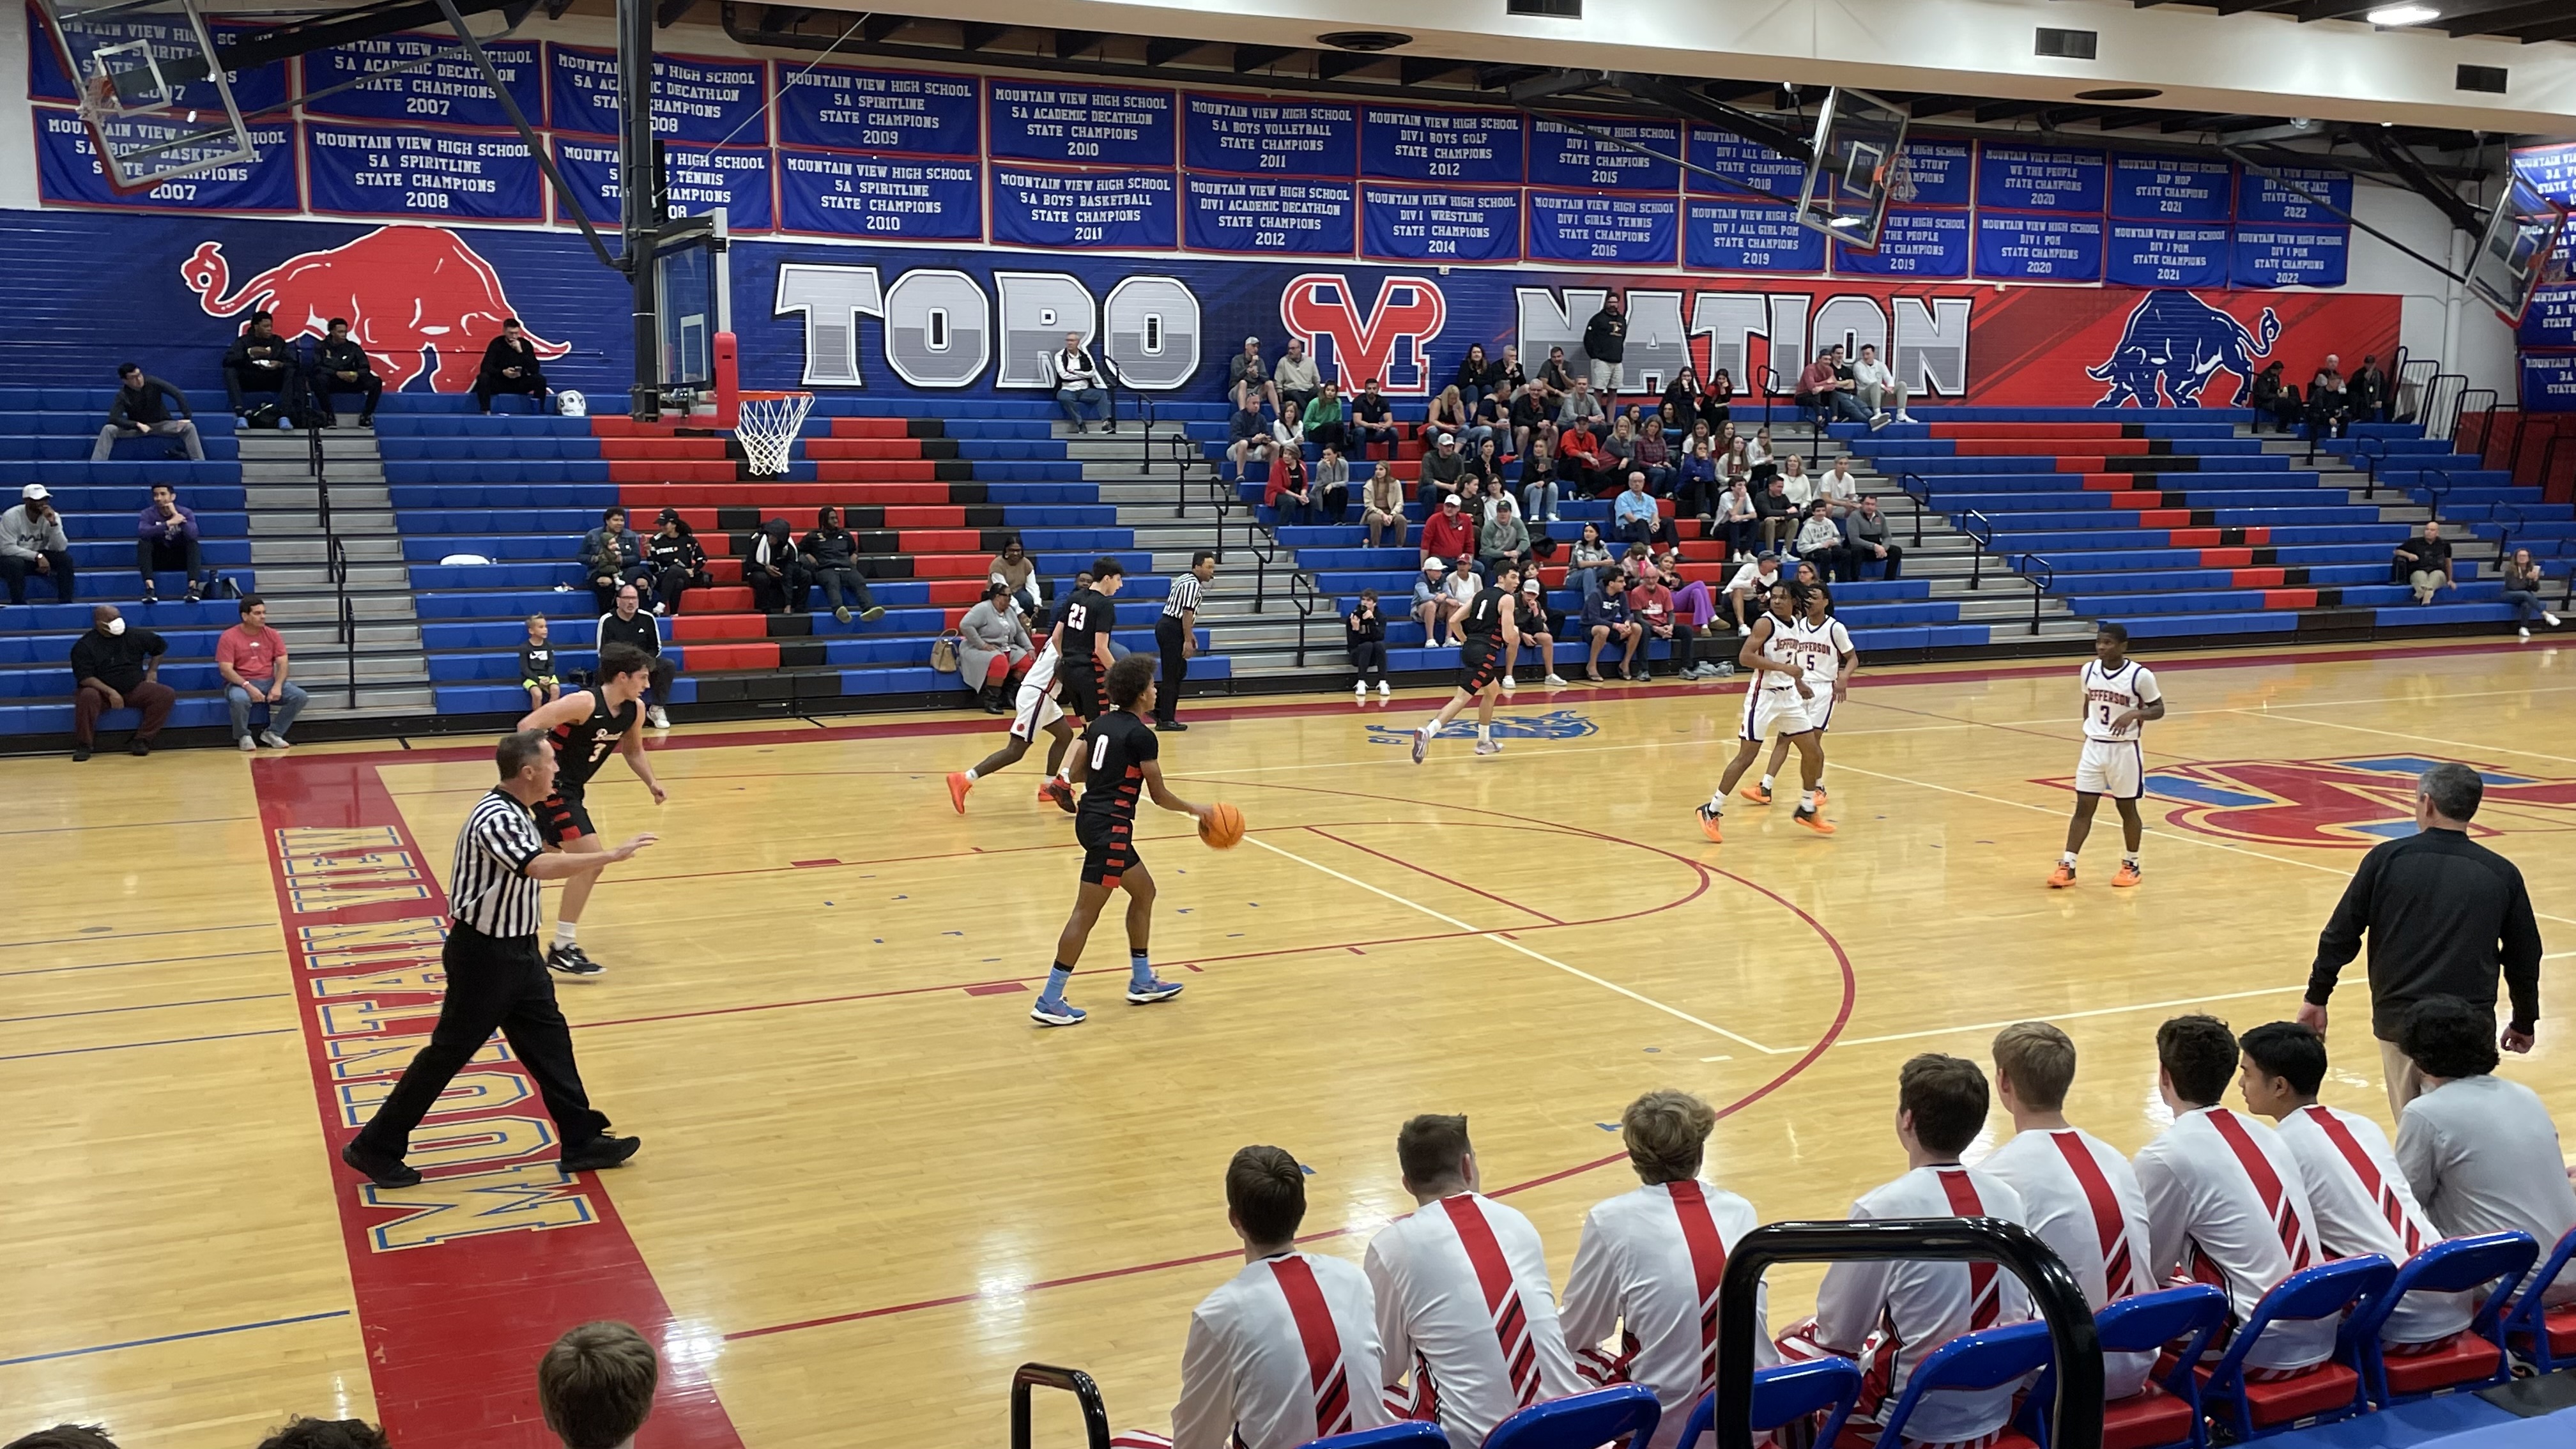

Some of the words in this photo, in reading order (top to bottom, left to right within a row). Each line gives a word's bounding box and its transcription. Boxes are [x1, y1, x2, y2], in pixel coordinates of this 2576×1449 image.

[397, 42, 431, 56] VIEW
[335, 56, 356, 70] 5A
[670, 65, 700, 82] HIGH
[706, 72, 755, 84] SCHOOL
[413, 80, 496, 98] CHAMPIONS
[786, 72, 850, 88] MOUNTAIN
[855, 78, 885, 91] VIEW
[891, 80, 919, 93] HIGH
[925, 82, 971, 96] SCHOOL
[667, 83, 740, 102] DECATHLON
[996, 89, 1055, 103] MOUNTAIN
[1059, 93, 1087, 104] VIEW
[1092, 95, 1119, 107] HIGH
[1124, 96, 1167, 109] SCHOOL
[407, 98, 449, 115] 2007
[834, 94, 851, 106] 5A
[859, 96, 924, 110] SPIRITLINE
[1012, 107, 1028, 118] 5A
[1034, 107, 1086, 121] ACADEMIC
[1091, 111, 1152, 125] DECATHLON
[1192, 101, 1247, 117] MOUNTAIN
[1252, 108, 1278, 119] VIEW
[1282, 109, 1307, 119] HIGH
[1311, 109, 1351, 121] SCHOOL
[820, 111, 859, 123] STATE
[868, 114, 939, 128] CHAMPIONS
[1369, 112, 1420, 126] MOUNTAIN
[1424, 117, 1449, 128] VIEW
[1453, 118, 1476, 128] HIGH
[1481, 118, 1518, 130] SCHOOL
[137, 125, 176, 141] VIEW
[1027, 124, 1062, 136] STATE
[1071, 126, 1137, 140] CHAMPIONS
[1213, 120, 1228, 131] 5A
[1233, 122, 1260, 134] BOYS
[1264, 124, 1331, 135] VOLLEYBALL
[316, 132, 391, 148] MOUNTAIN
[397, 137, 431, 150] VIEW
[438, 140, 472, 155] HIGH
[479, 144, 531, 157] SCHOOL
[863, 130, 898, 144] 2009
[1221, 137, 1255, 150] STATE
[1262, 139, 1323, 151] CHAMPIONS
[1430, 132, 1457, 144] BOYS
[1463, 134, 1487, 144] GOLF
[1068, 142, 1098, 156] 2010
[1395, 145, 1427, 157] STATE
[1434, 148, 1492, 158] CHAMPIONS
[369, 155, 389, 167] 5A
[401, 155, 480, 173] SPIRITLINE
[715, 157, 765, 169] SCHOOL
[1261, 155, 1285, 167] 2011
[1560, 153, 1590, 165] STATE
[1597, 156, 1649, 167] CHAMPIONS
[788, 158, 852, 175] MOUNTAIN
[857, 165, 887, 177] VIEW
[893, 167, 921, 179] HIGH
[926, 168, 972, 180] SCHOOL
[1430, 163, 1459, 175] 2012
[1592, 170, 1618, 183] 2015
[356, 172, 402, 186] STATE
[413, 174, 495, 192] CHAMPIONS
[677, 171, 724, 186] TENNIS
[1000, 174, 1061, 189] MOUNTAIN
[1064, 180, 1093, 190] VIEW
[1097, 180, 1124, 190] HIGH
[1128, 178, 1170, 190] SCHOOL
[150, 184, 197, 201] 2007
[836, 180, 852, 192] 5A
[860, 182, 929, 197] SPIRITLINE
[1191, 181, 1246, 195] MOUNTAIN
[1250, 185, 1276, 196] VIEW
[1280, 186, 1305, 197] HIGH
[1309, 188, 1350, 200] SCHOOL
[2537, 181, 2568, 194] STATE
[406, 192, 448, 208] 2008
[822, 195, 861, 210] STATE
[870, 199, 941, 213] CHAMPIONS
[1020, 192, 1038, 204] 5A
[1043, 194, 1073, 206] BOYS
[1080, 194, 1152, 206] BASKETBALL
[1367, 192, 1418, 205] MOUNTAIN
[1422, 195, 1447, 205] VIEW
[1450, 196, 1475, 207] HIGH
[1478, 197, 1515, 208] SCHOOL
[1535, 197, 1583, 210] MOUNTAIN
[1587, 200, 1609, 210] VIEW
[1613, 202, 1636, 212] HIGH
[1639, 203, 1674, 213] SCHOOL
[2031, 193, 2055, 204] 2020
[1229, 200, 1279, 211] ACADEMIC
[1282, 202, 1340, 215] DECATHLON
[1692, 208, 1738, 219] MOUNTAIN
[1740, 210, 1763, 221] VIEW
[1766, 211, 1787, 222] HIGH
[866, 216, 900, 230] 2010
[1032, 210, 1068, 222] STATE
[1076, 210, 1140, 222] CHAMPIONS
[1219, 216, 1253, 227] STATE
[1261, 217, 1321, 229] CHAMPIONS
[1431, 210, 1483, 222] WRESTLING
[1584, 215, 1612, 225] GIRLS
[1618, 217, 1652, 227] TENNIS
[1075, 227, 1101, 240] 2011
[1393, 226, 1425, 236] STATE
[1432, 226, 1489, 238] CHAMPIONS
[1560, 229, 1589, 239] STATE
[1595, 230, 1650, 242] CHAMPIONS
[1739, 224, 1755, 234] ALL
[1758, 225, 1777, 235] GIRL
[1781, 226, 1799, 236] POM
[1255, 232, 1285, 245] 2012
[1714, 237, 1744, 247] STATE
[1748, 238, 1798, 250] CHAMPIONS
[1429, 240, 1455, 253] 2014
[1591, 244, 1617, 256] 2016
[1743, 252, 1769, 264] 2019
[1890, 258, 1915, 270] 2019
[2158, 268, 2179, 280] 2021
[2276, 272, 2299, 283] 2022
[775, 263, 1200, 390] TORO
[1515, 288, 1973, 396] NATION
[1068, 602, 1086, 631] 23
[1476, 599, 1488, 620] 1
[1807, 654, 1815, 671] 5
[2100, 705, 2110, 725] 3
[1091, 734, 1109, 770] 0
[275, 825, 433, 914] VIEW
